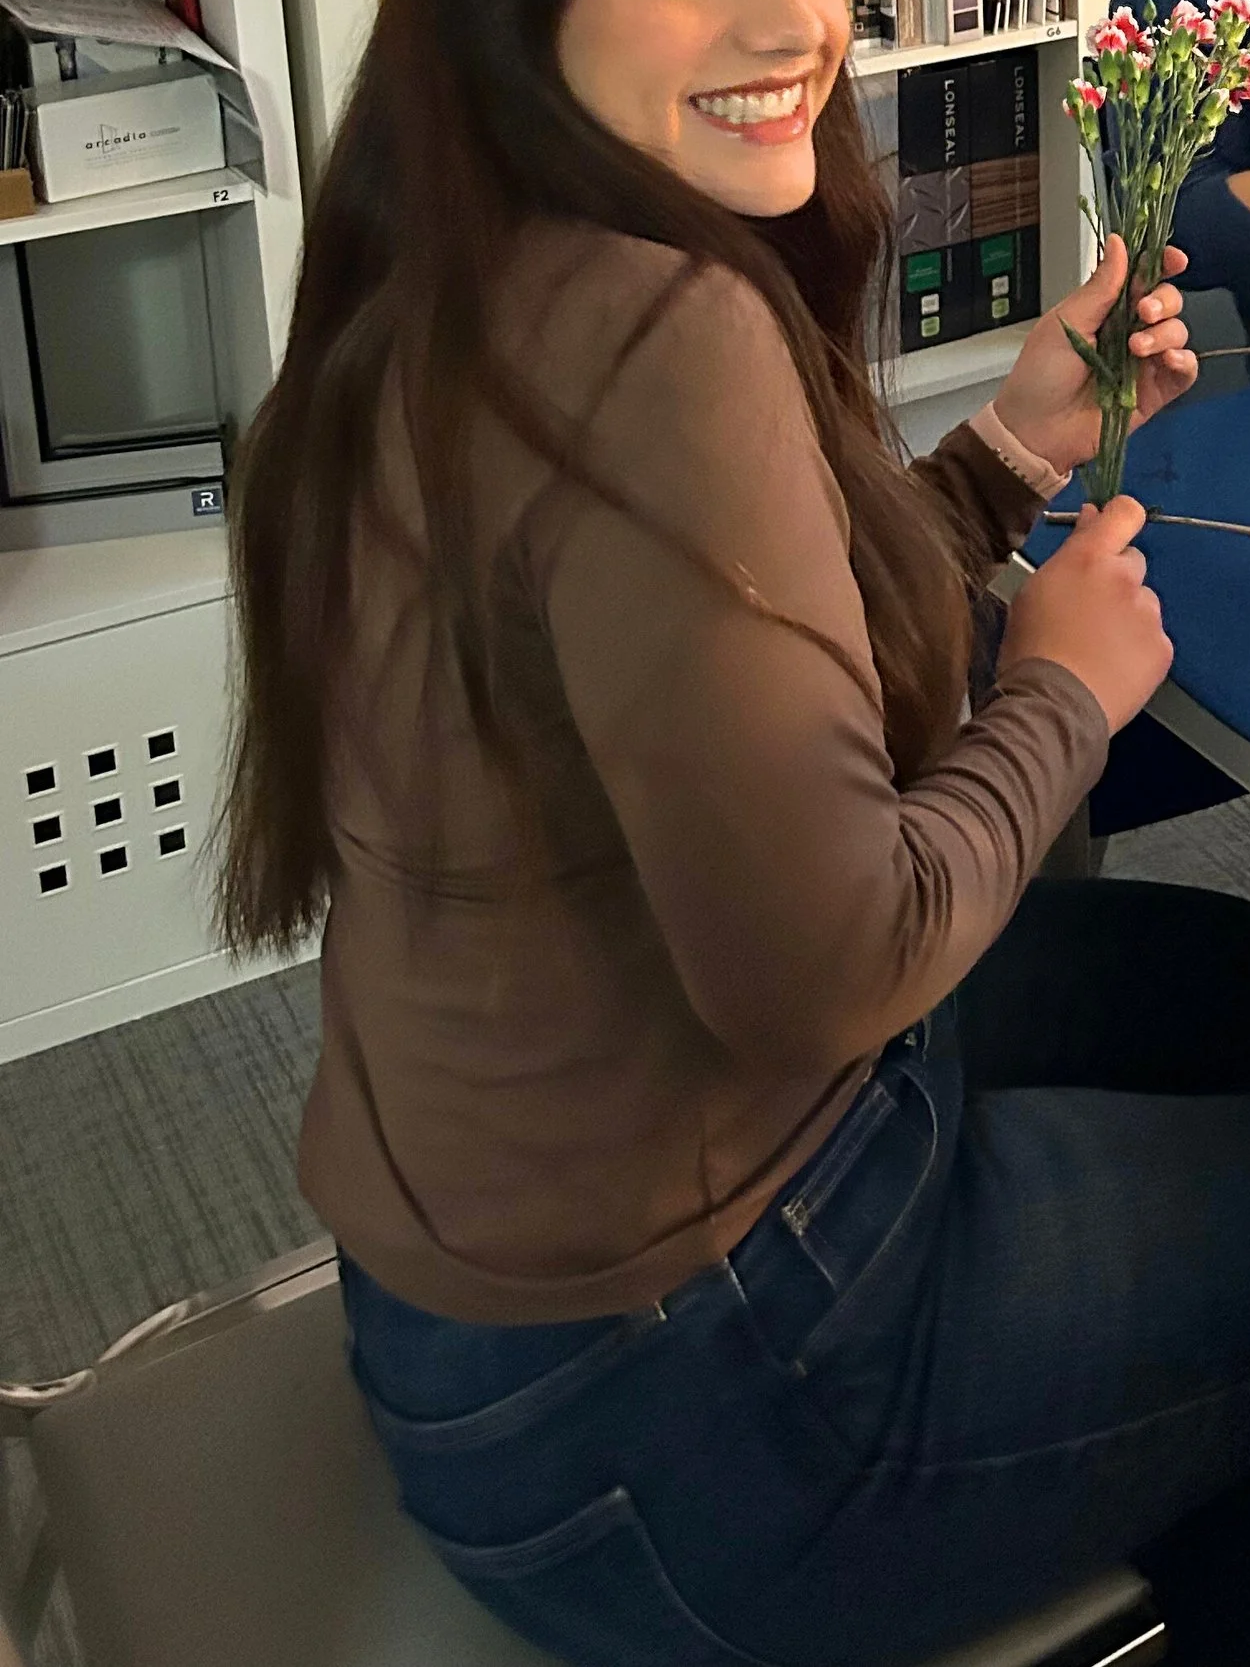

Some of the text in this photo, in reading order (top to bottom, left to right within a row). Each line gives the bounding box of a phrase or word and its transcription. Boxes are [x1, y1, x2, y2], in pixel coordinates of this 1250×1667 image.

[1047, 27, 1061, 37] G6
[1013, 65, 1025, 147] LONSEAL
[944, 79, 956, 162] LONSEAL
[85, 131, 147, 150] arcadia
[213, 190, 230, 203] F2
[200, 492, 214, 507] R
